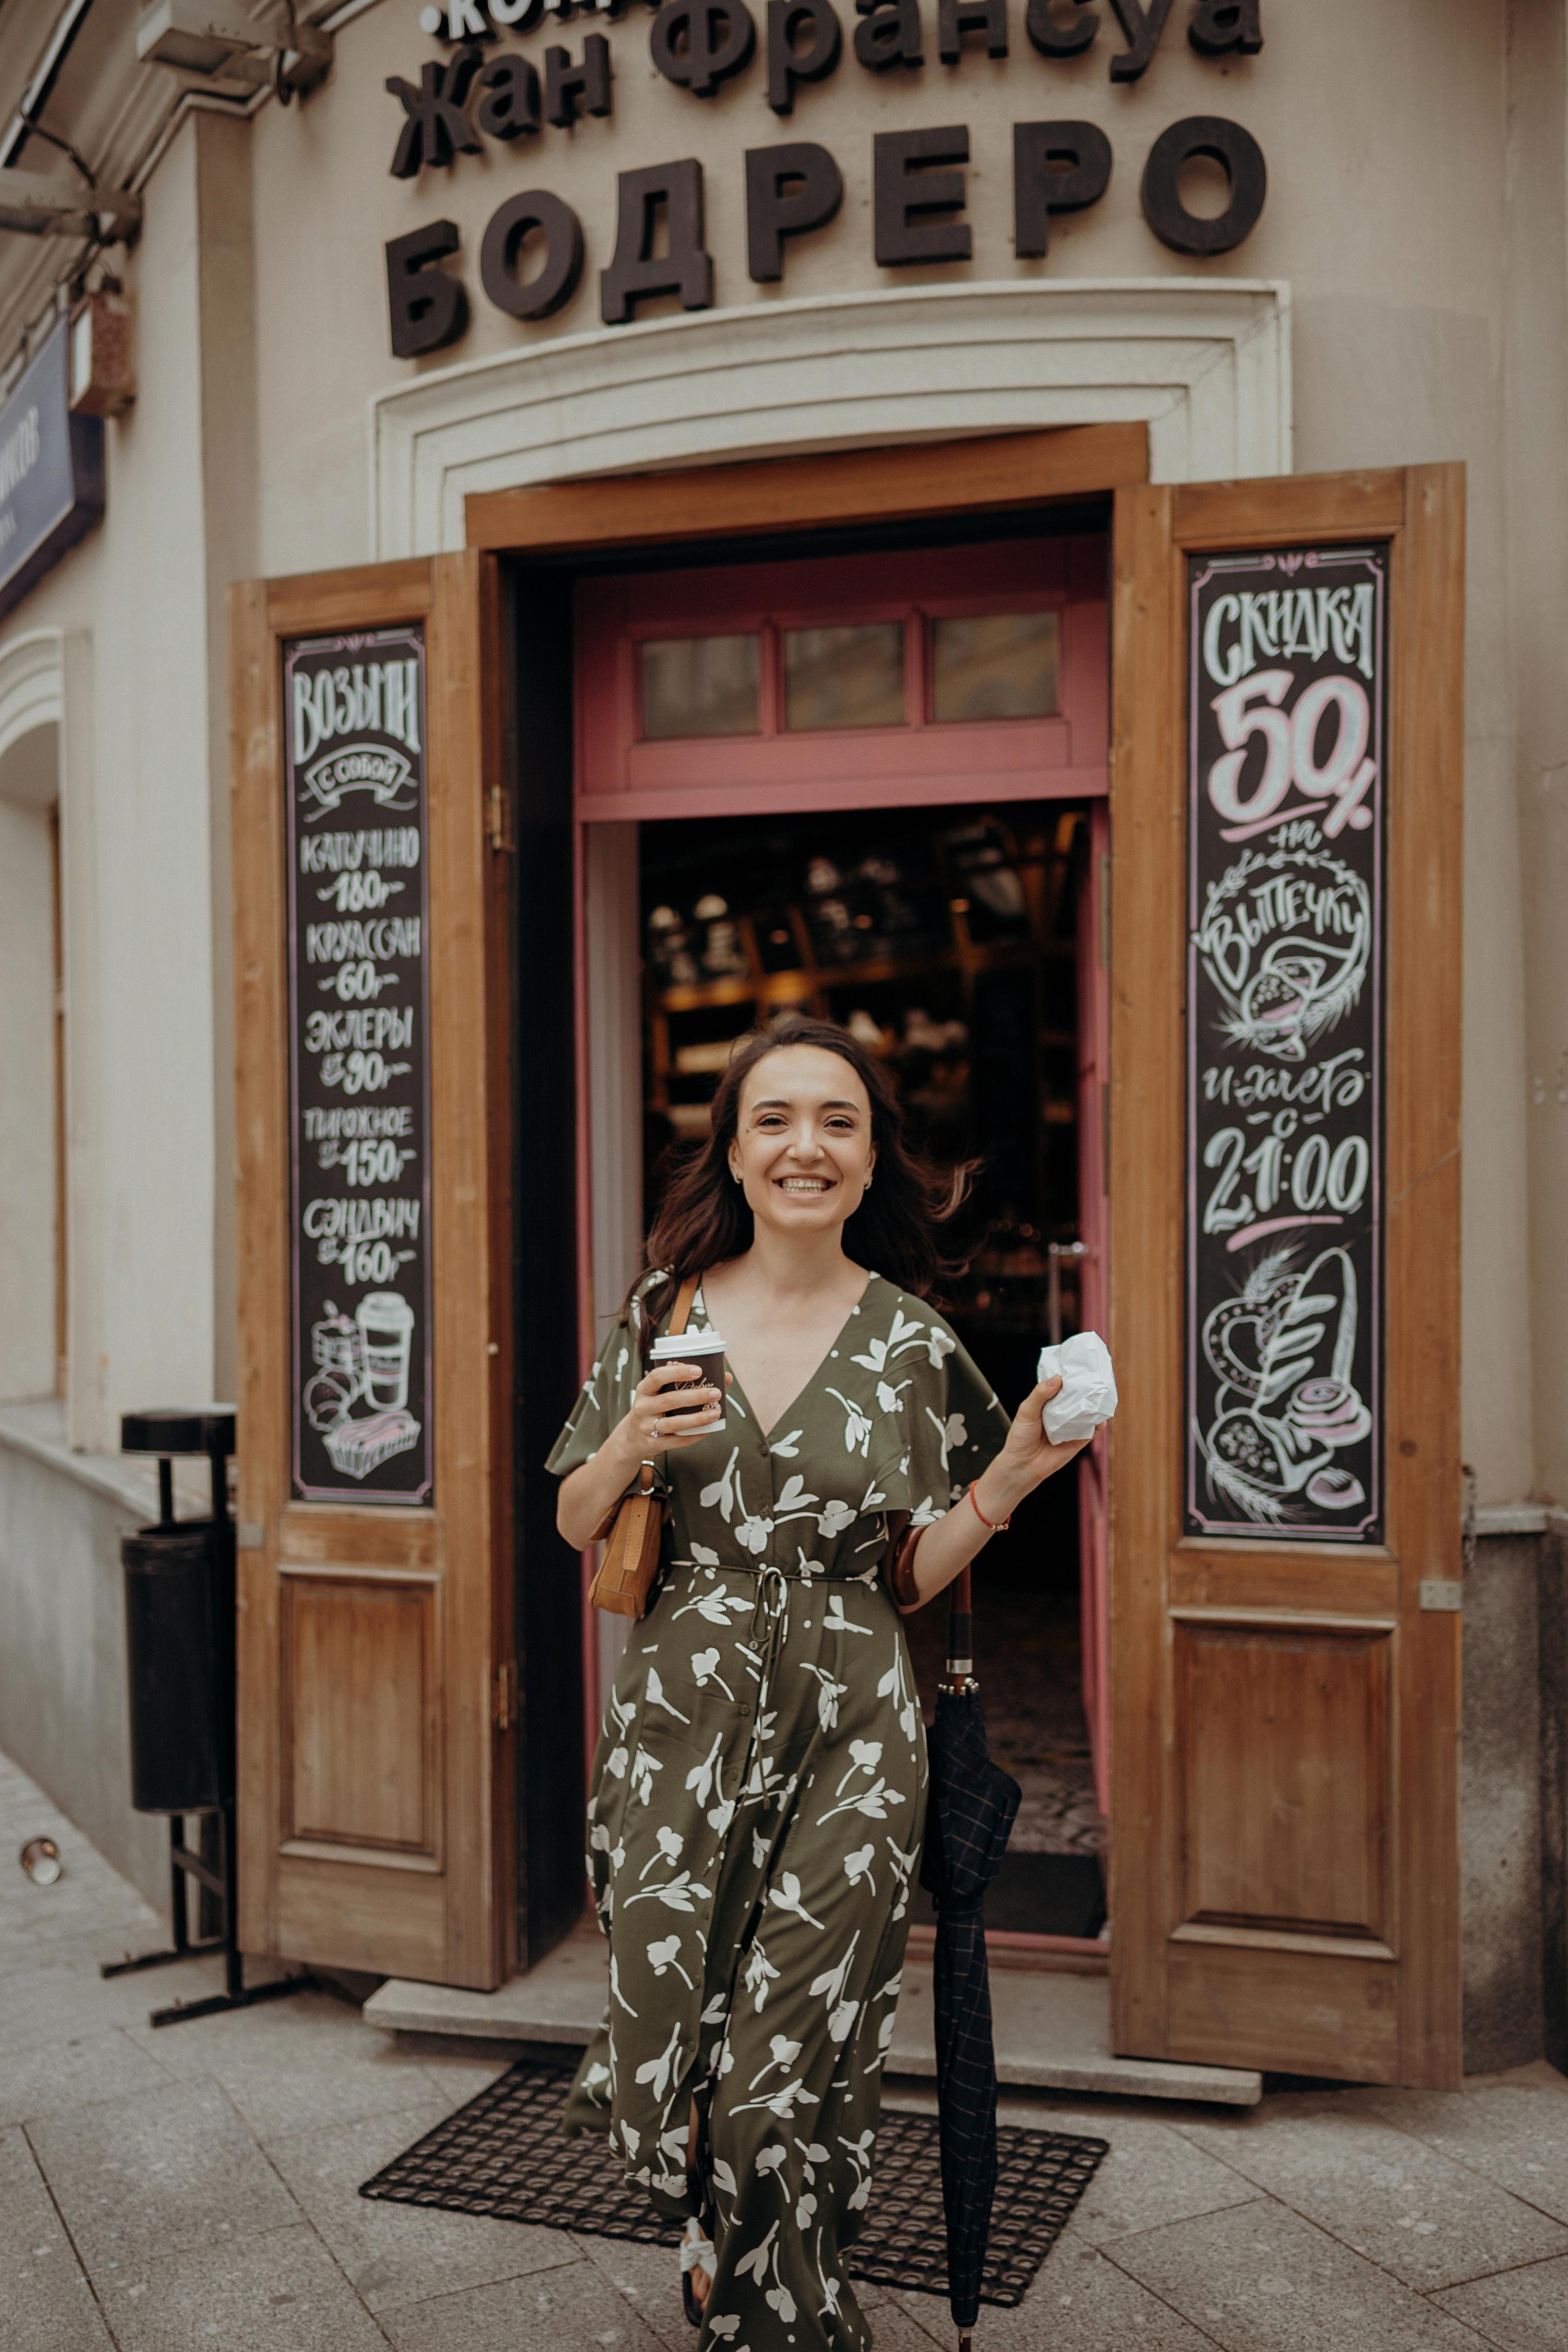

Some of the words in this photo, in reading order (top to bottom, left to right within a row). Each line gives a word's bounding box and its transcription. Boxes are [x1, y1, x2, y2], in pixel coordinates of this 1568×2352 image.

[385, 33, 611, 178] Жан
[385, 115, 1267, 358] БОДРЕРО
[1204, 582, 1375, 687] СКИДКА
[294, 658, 421, 765] ВОЗЬМИ
[1208, 668, 1376, 839] 50%
[300, 826, 420, 874] КАПУЧИНО
[306, 915, 421, 964] КРУАССАН
[305, 1005, 413, 1053] ЭКЛЕРЫ
[303, 1197, 420, 1245] СЭНДВИЧ
[1203, 1126, 1370, 1235] 21:00
